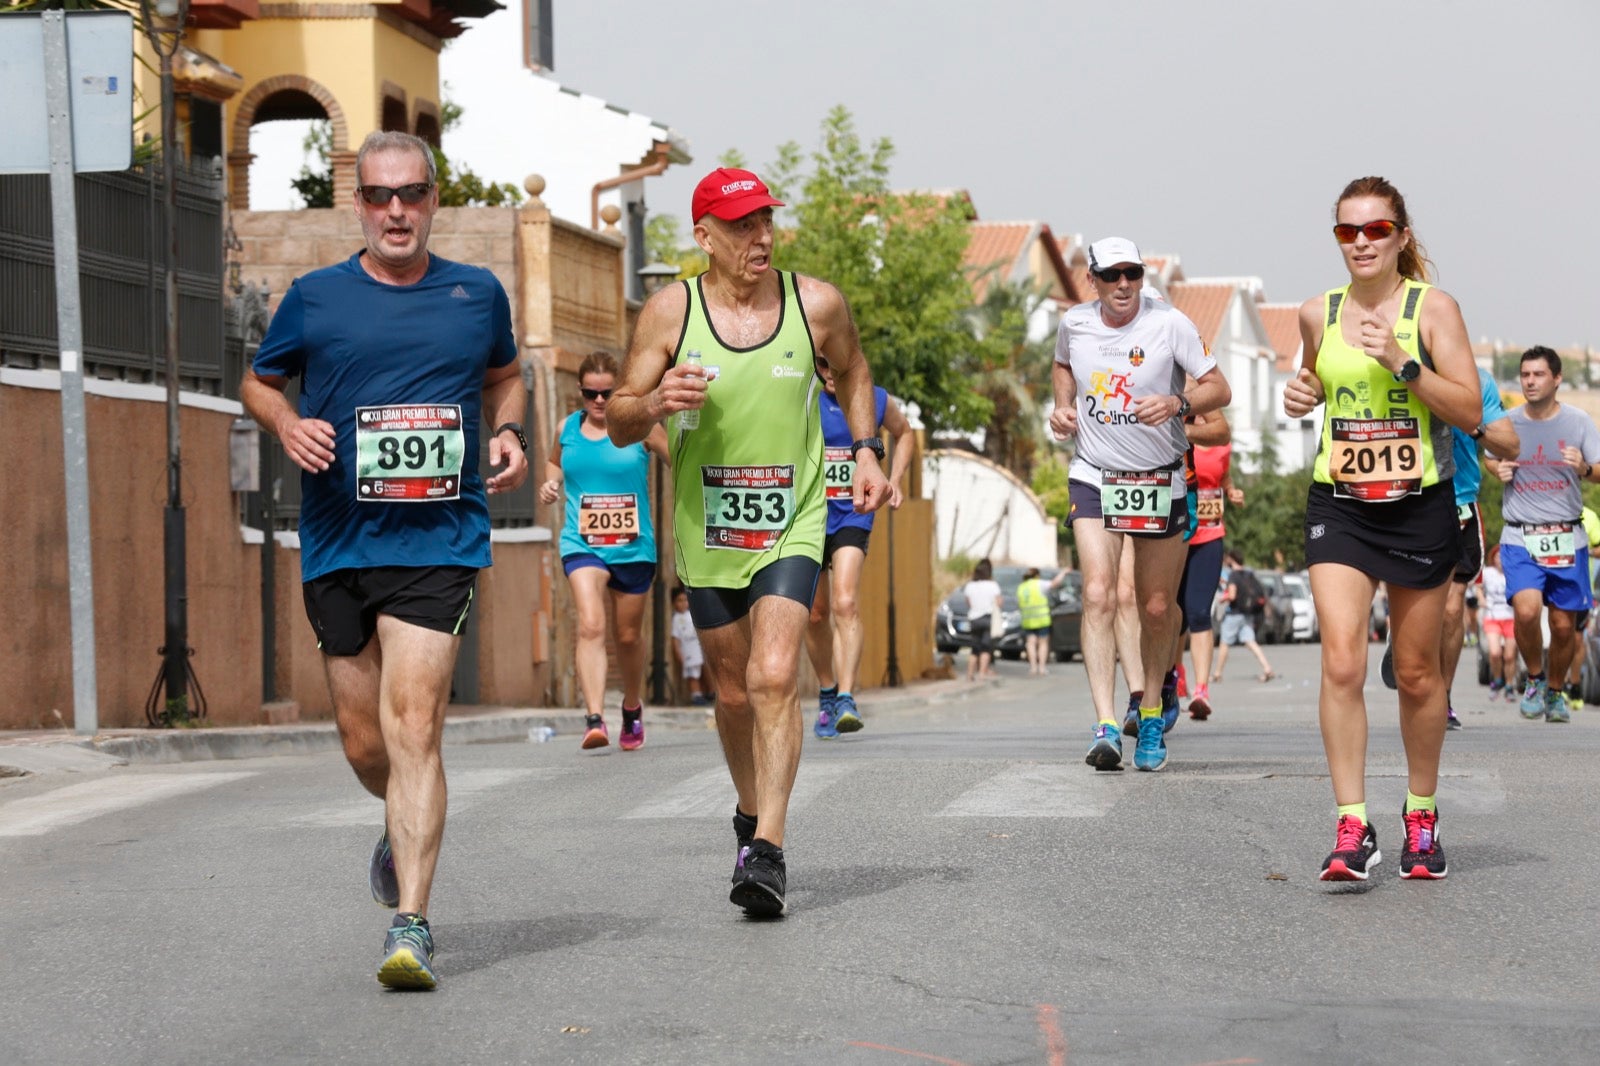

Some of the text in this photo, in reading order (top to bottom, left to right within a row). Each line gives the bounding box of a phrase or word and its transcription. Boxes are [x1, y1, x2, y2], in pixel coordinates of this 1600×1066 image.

[382, 409, 401, 421] GRAN
[402, 408, 427, 420] PREMIO
[428, 408, 436, 419] DE
[378, 436, 445, 470] 891
[1340, 444, 1416, 474] 2019
[723, 468, 740, 478] GRAN
[741, 468, 764, 479] PREMIO
[765, 468, 773, 478] DE
[720, 492, 786, 523] 353
[1114, 488, 1158, 511] 391
[588, 512, 634, 529] 2035
[1540, 536, 1560, 552] 81
